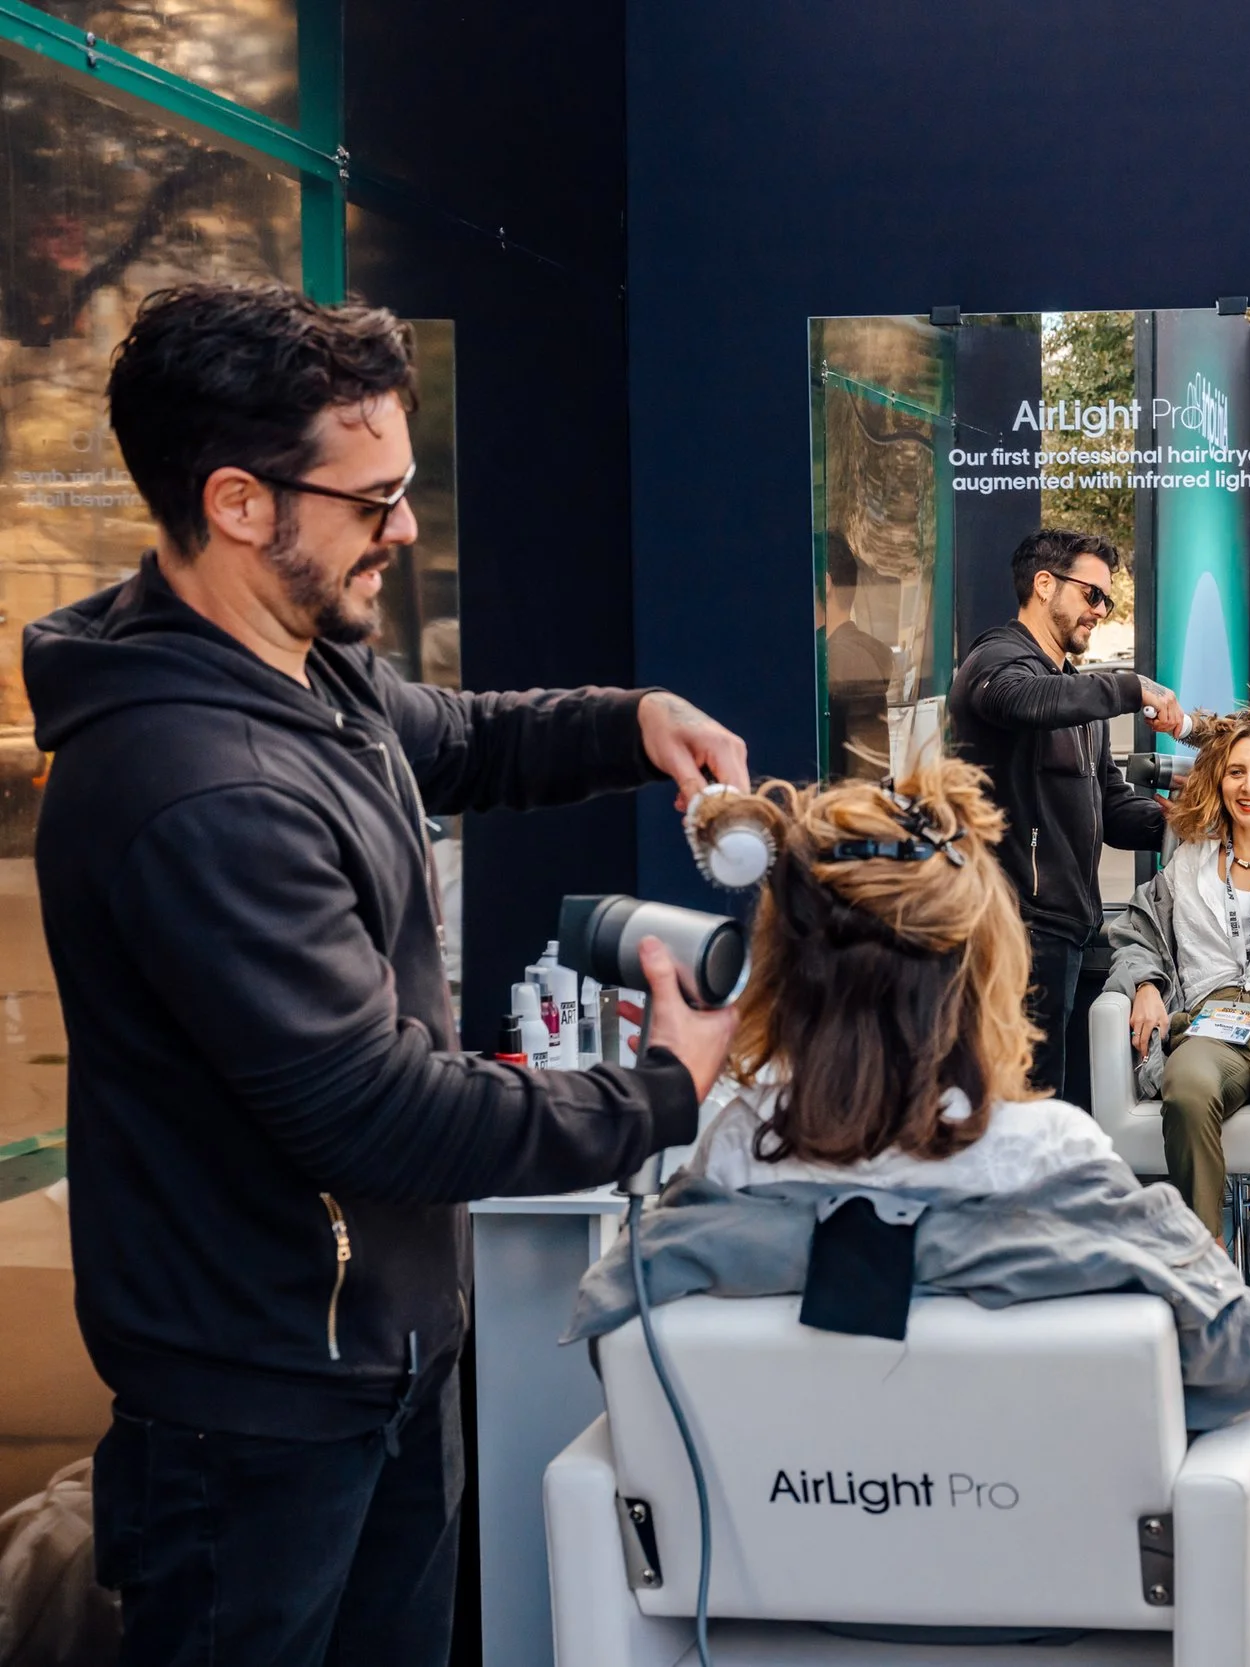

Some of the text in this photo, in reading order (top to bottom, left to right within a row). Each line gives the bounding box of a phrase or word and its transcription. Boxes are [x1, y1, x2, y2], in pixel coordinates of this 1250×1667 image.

[1012, 398, 1204, 438] AirLight Pro
[949, 448, 987, 466] Our
[991, 447, 1030, 466] first
[1034, 446, 1162, 469] professional
[1167, 445, 1208, 463] hair
[952, 472, 1074, 495] augmented
[1078, 471, 1122, 490] with
[1127, 470, 1209, 489] infrared
[561, 1009, 576, 1025] ART
[769, 1469, 1019, 1514] AirLight Pro
